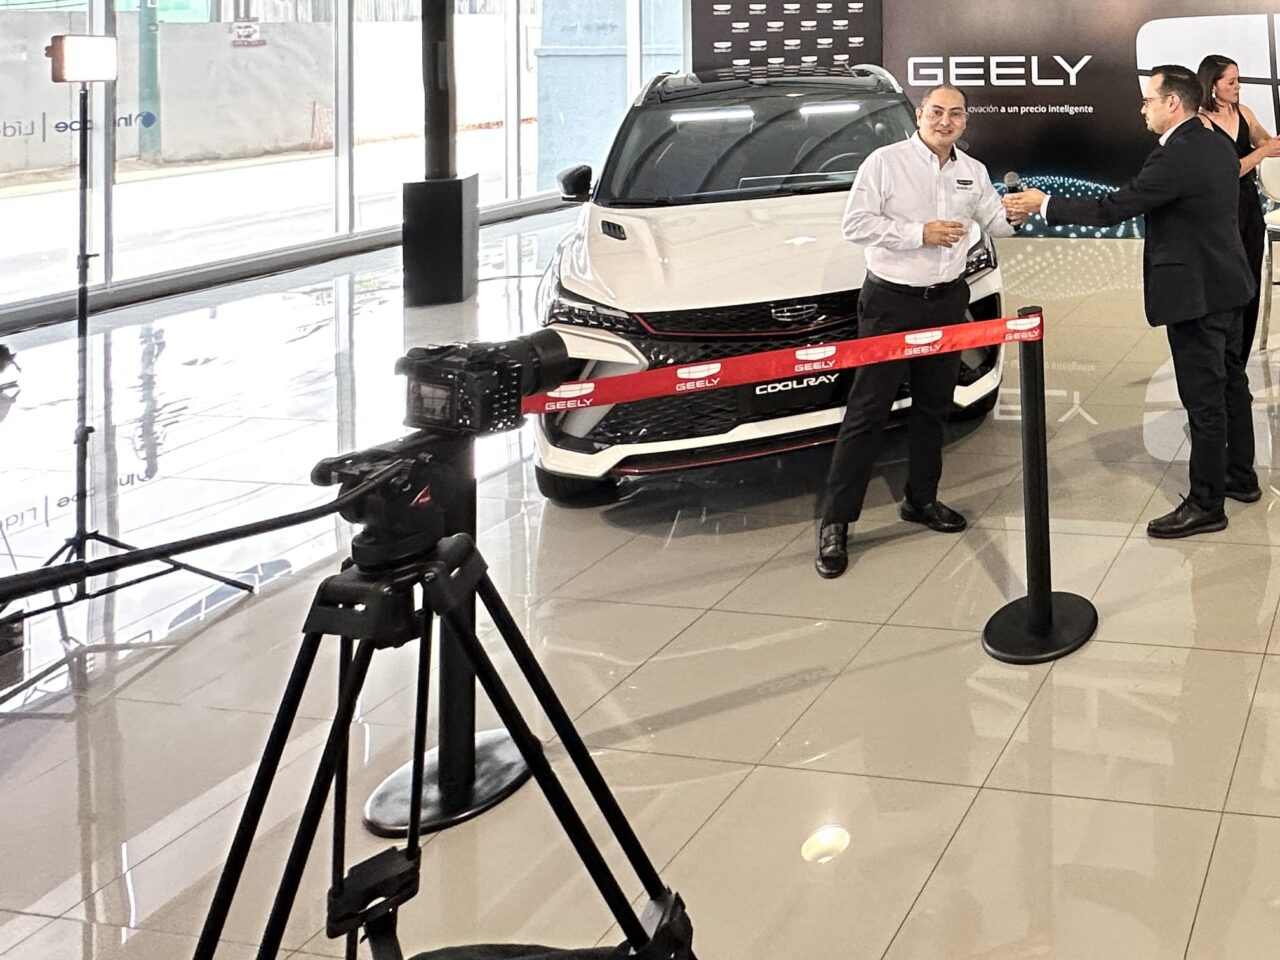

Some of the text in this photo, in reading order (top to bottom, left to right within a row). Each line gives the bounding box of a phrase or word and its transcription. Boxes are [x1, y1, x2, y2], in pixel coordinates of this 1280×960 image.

[907, 55, 1093, 87] GEELY
[1007, 105, 1019, 113] un
[1020, 104, 1047, 115] precio
[1048, 104, 1094, 115] inteligente
[1004, 329, 1040, 341] GEELY
[904, 343, 942, 356] GEELY
[794, 359, 836, 372] GEELY
[675, 377, 721, 391] GEELY
[755, 373, 839, 395] COOLRAY
[545, 398, 593, 411] GEELY
